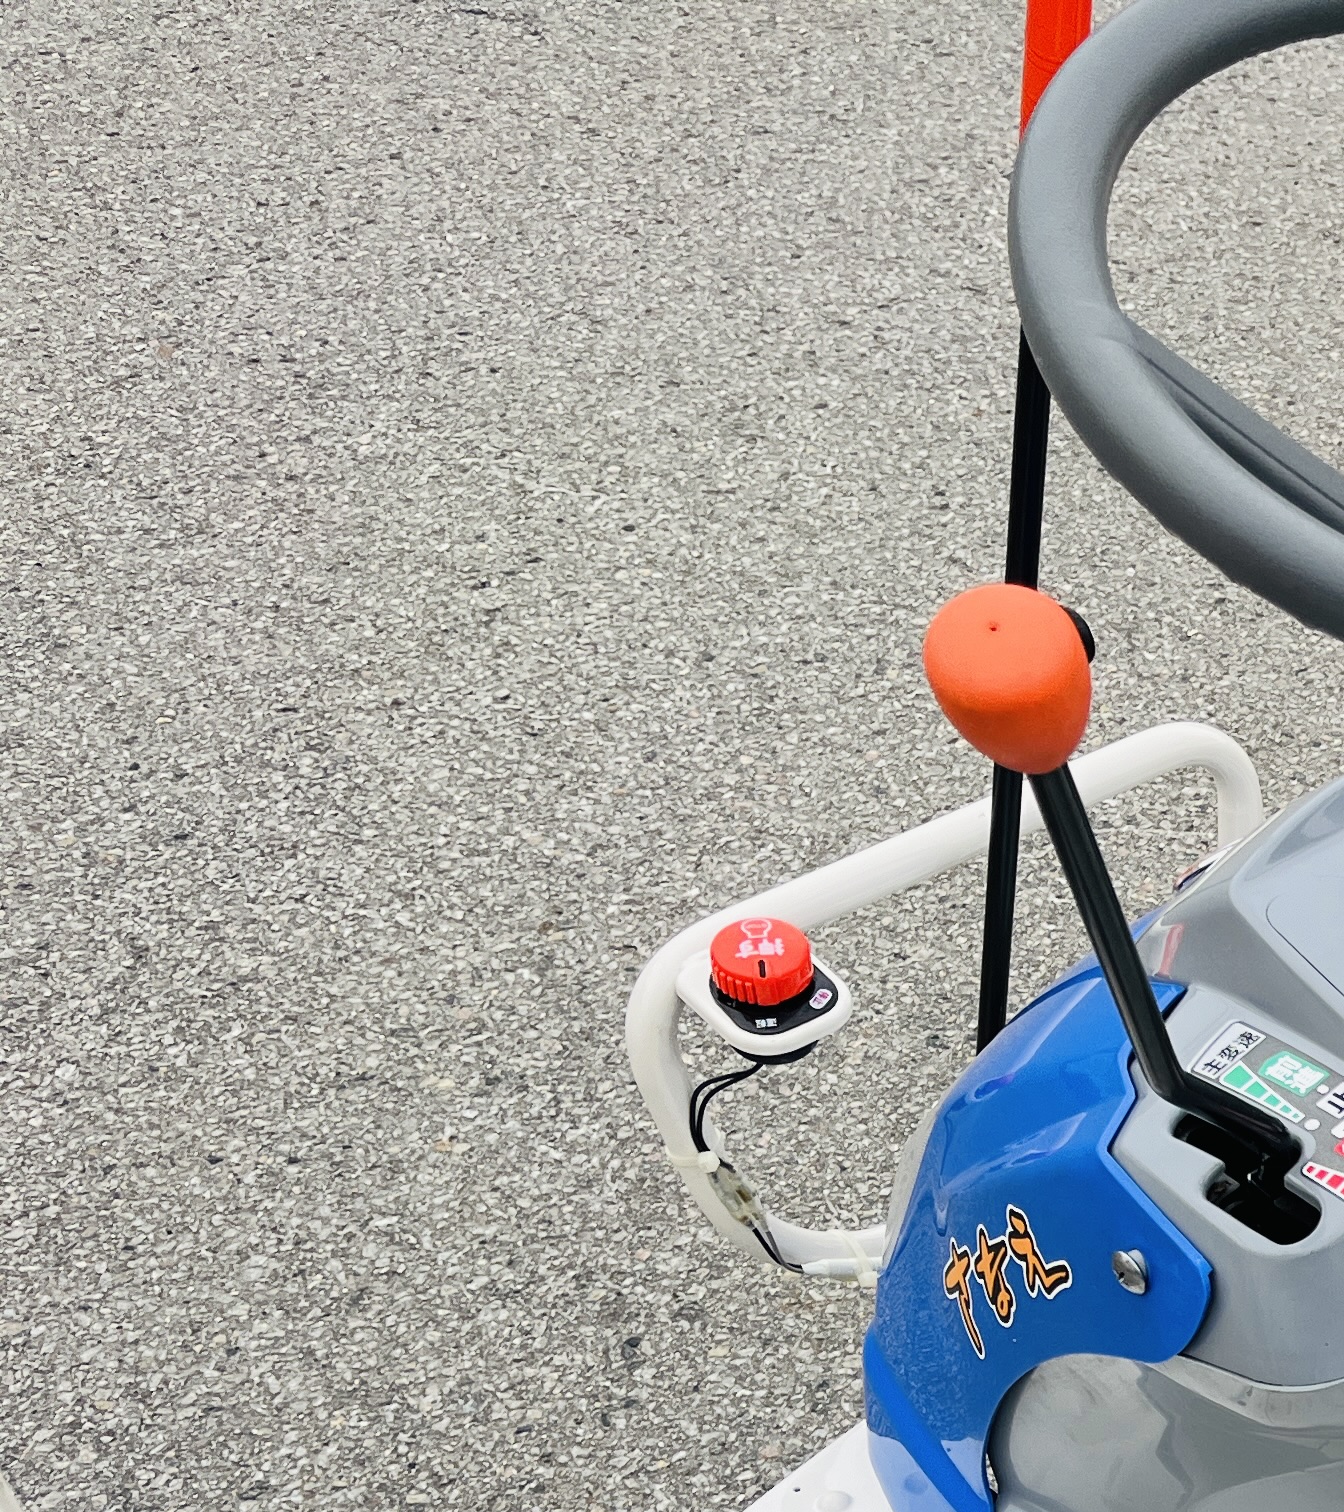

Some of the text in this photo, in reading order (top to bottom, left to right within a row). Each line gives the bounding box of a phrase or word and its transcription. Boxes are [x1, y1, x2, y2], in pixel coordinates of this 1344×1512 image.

[1202, 1031, 1260, 1076] 主変速
[1265, 1054, 1326, 1096] 前進
[943, 1204, 1073, 1360] さなえ
